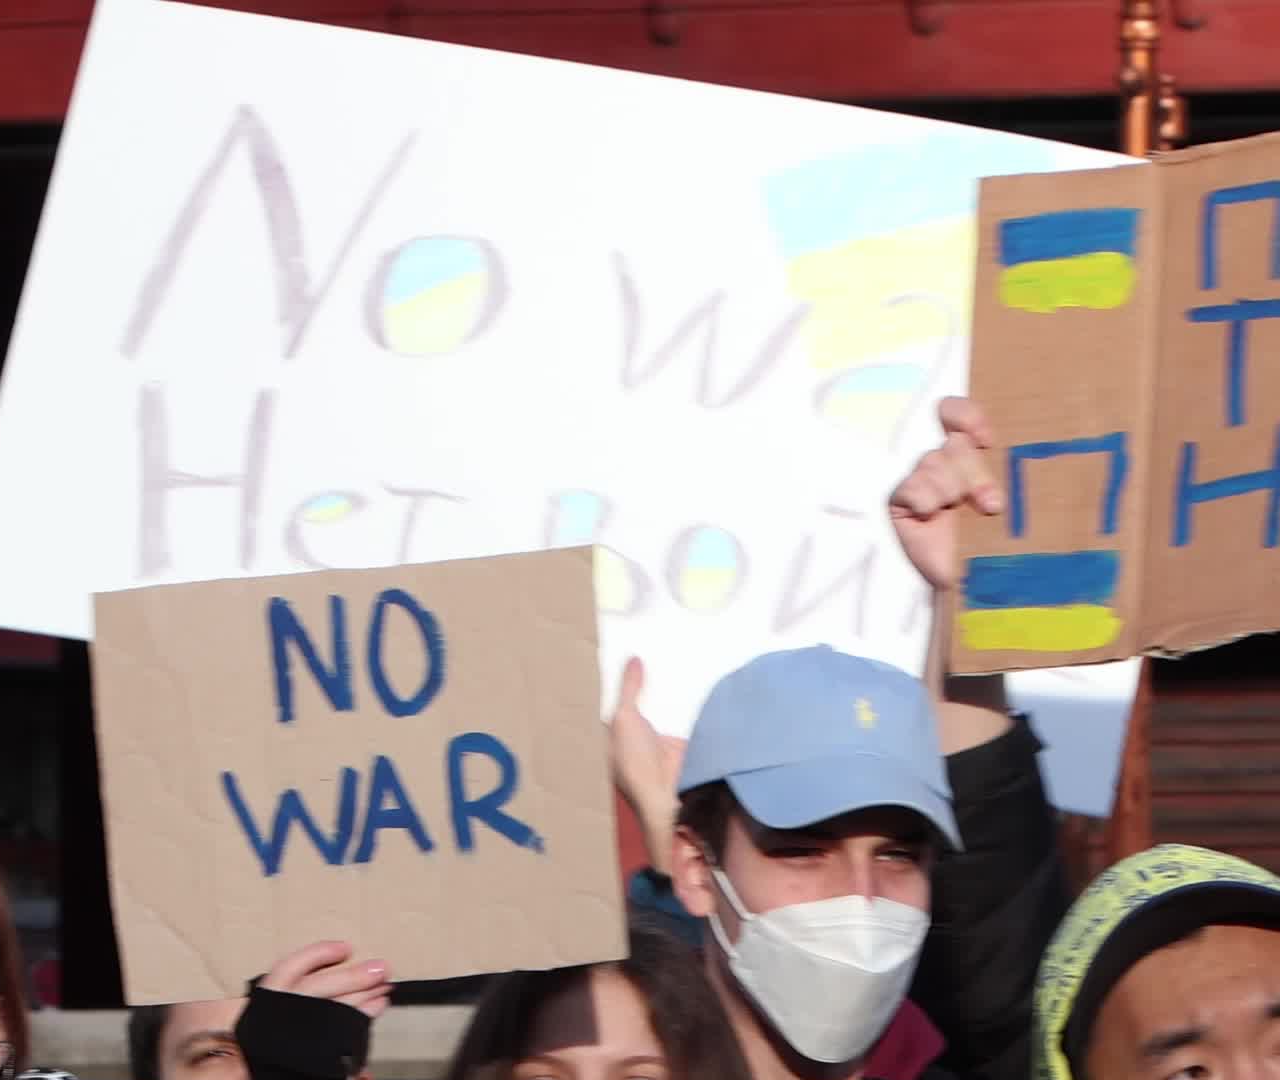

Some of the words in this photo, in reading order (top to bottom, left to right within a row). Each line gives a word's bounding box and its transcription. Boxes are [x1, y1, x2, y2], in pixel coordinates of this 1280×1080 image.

[118, 100, 514, 362] No
[266, 587, 447, 725] NO
[220, 731, 546, 879] WAR
